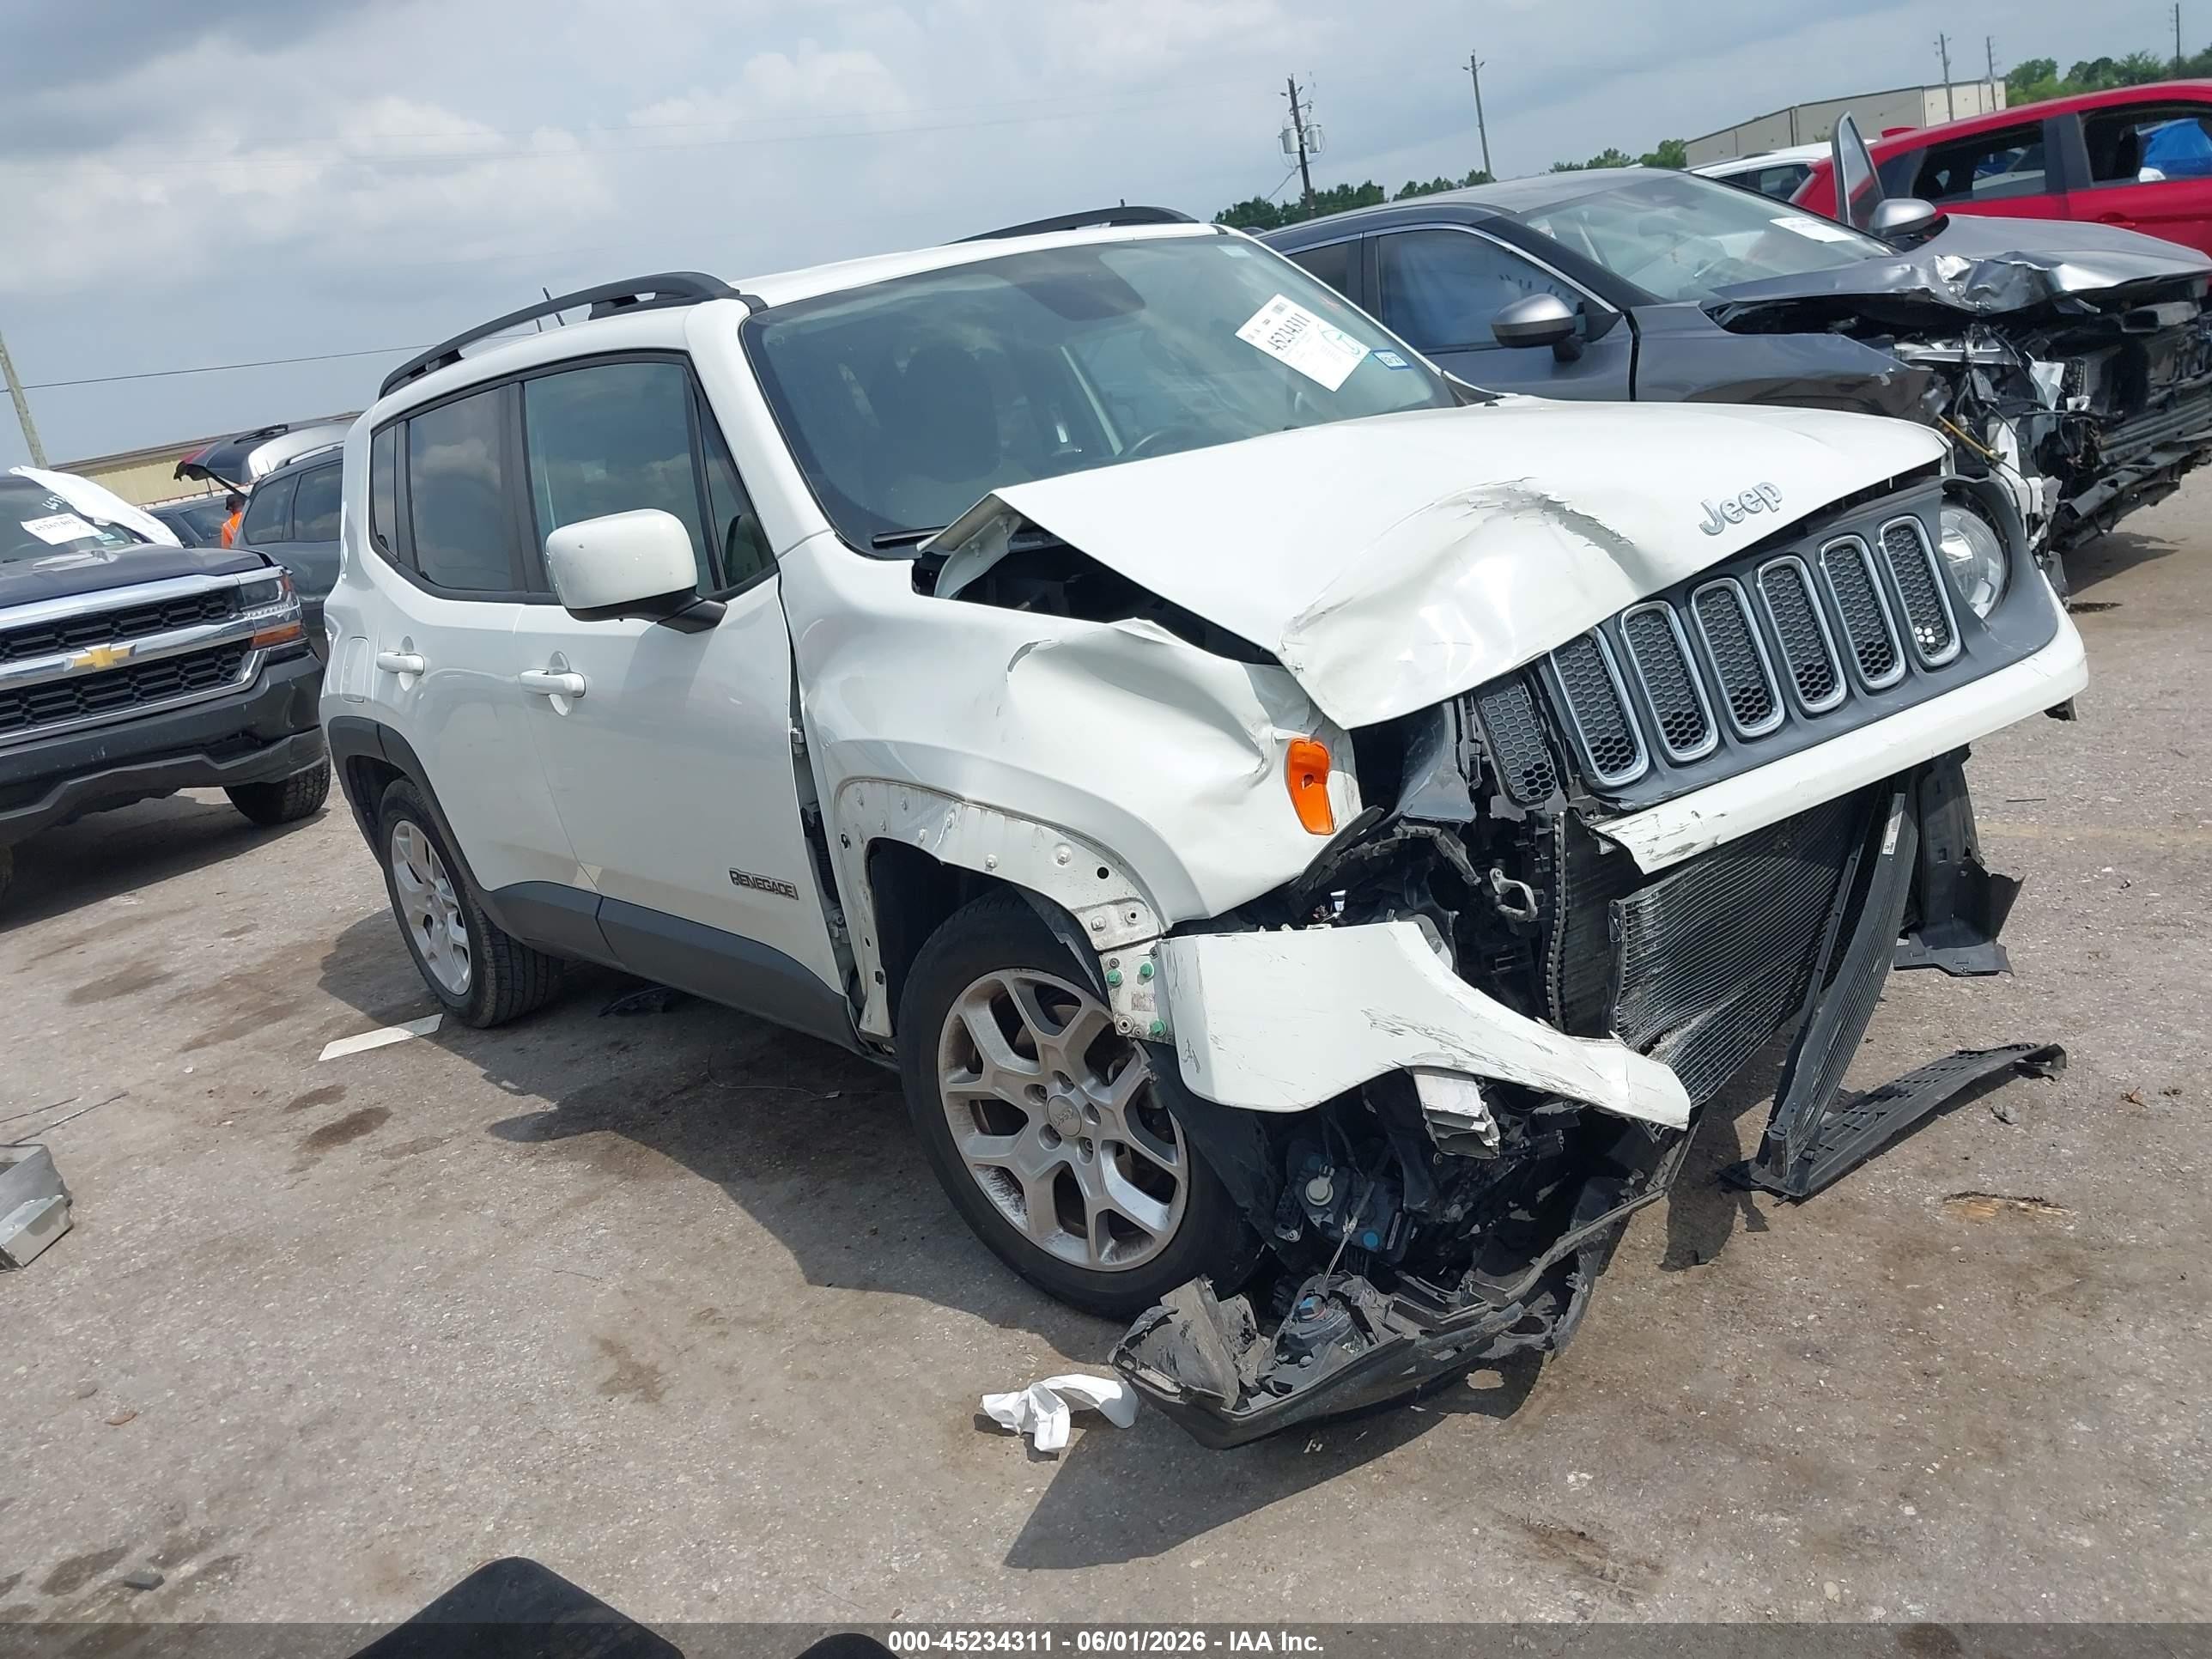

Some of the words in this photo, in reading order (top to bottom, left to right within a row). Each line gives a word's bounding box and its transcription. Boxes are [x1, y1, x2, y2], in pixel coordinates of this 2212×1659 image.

[1267, 312, 1311, 351] 45234311
[1698, 481, 1783, 537] Jeep
[728, 867, 797, 899] RENEGADE
